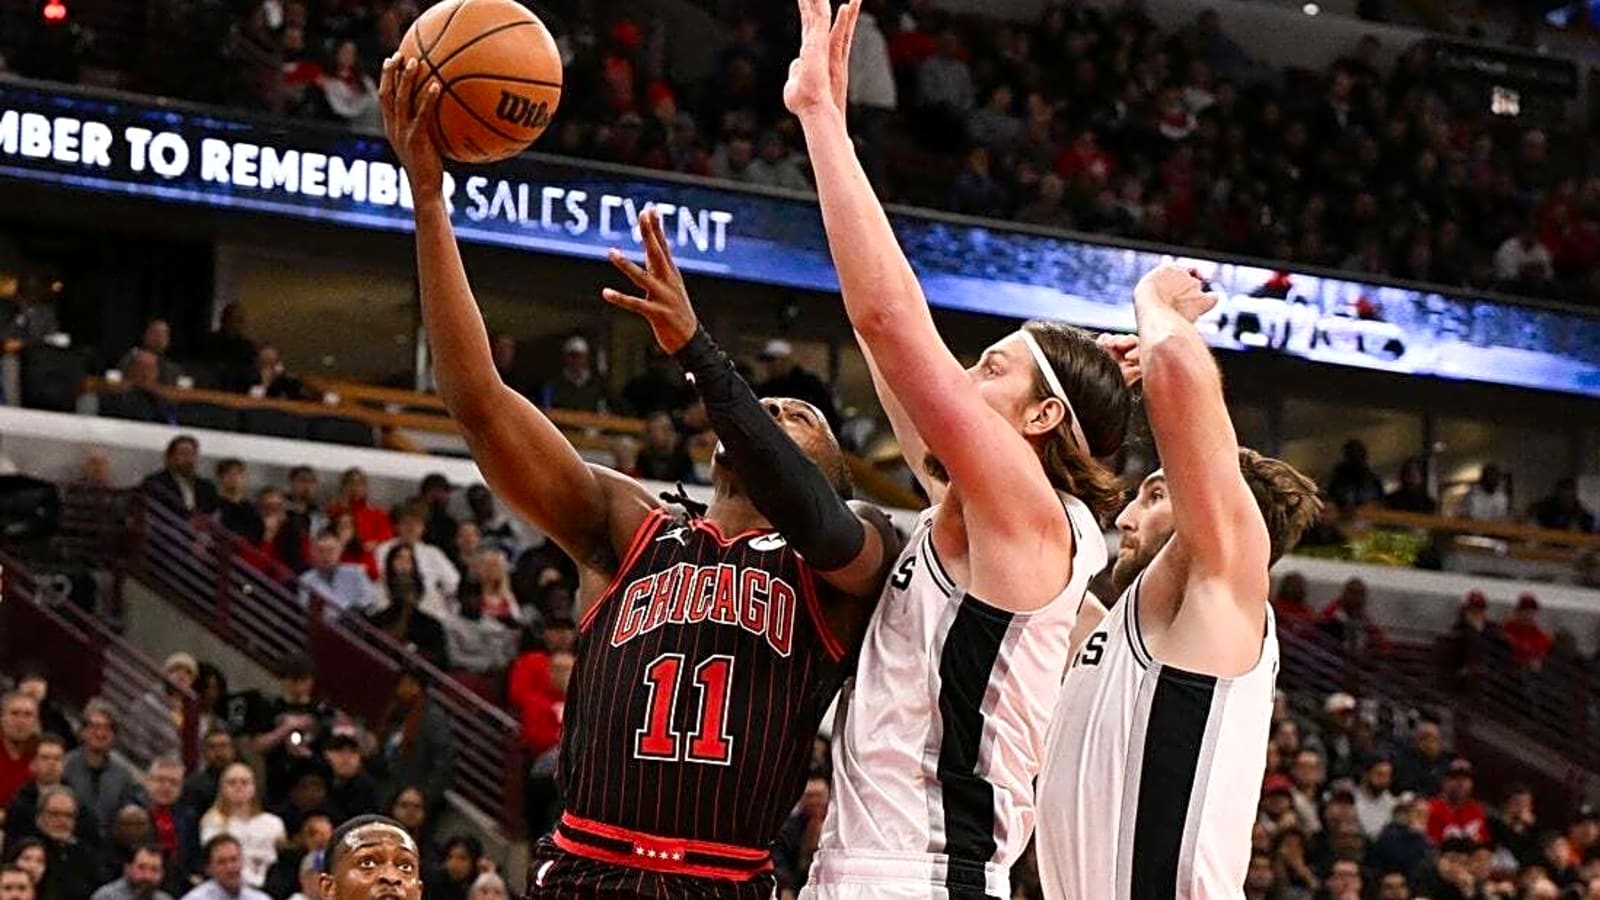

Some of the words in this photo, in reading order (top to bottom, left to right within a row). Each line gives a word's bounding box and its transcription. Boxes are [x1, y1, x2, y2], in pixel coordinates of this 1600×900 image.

[125, 126, 190, 178] TO
[611, 562, 796, 658] CHICAGO
[634, 653, 735, 766] 11
